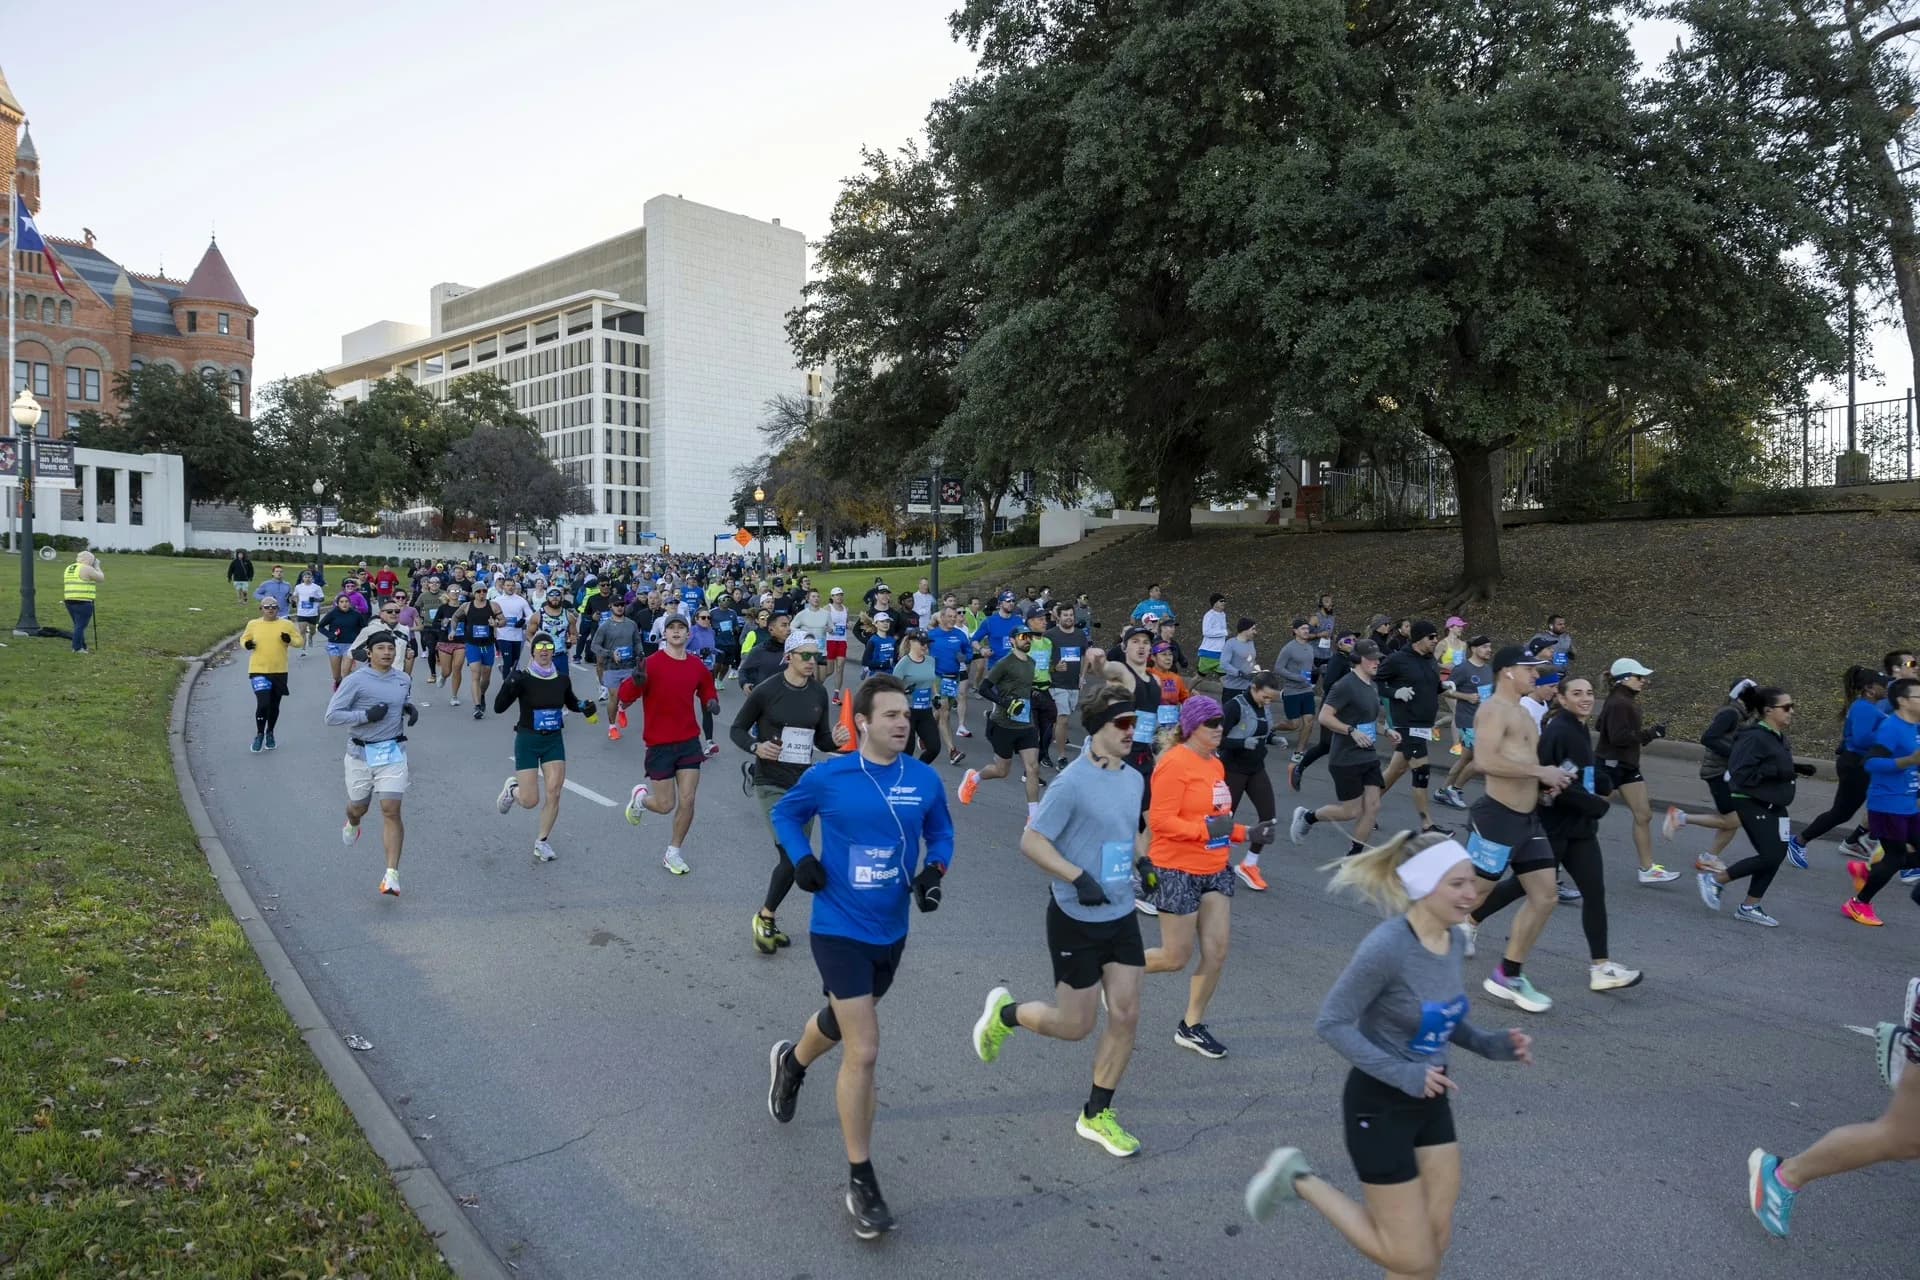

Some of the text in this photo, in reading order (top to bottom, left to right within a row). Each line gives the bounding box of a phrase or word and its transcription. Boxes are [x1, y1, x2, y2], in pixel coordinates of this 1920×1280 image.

[51, 456, 68, 464] idea
[39, 462, 57, 470] lives
[1113, 864, 1120, 873] A
